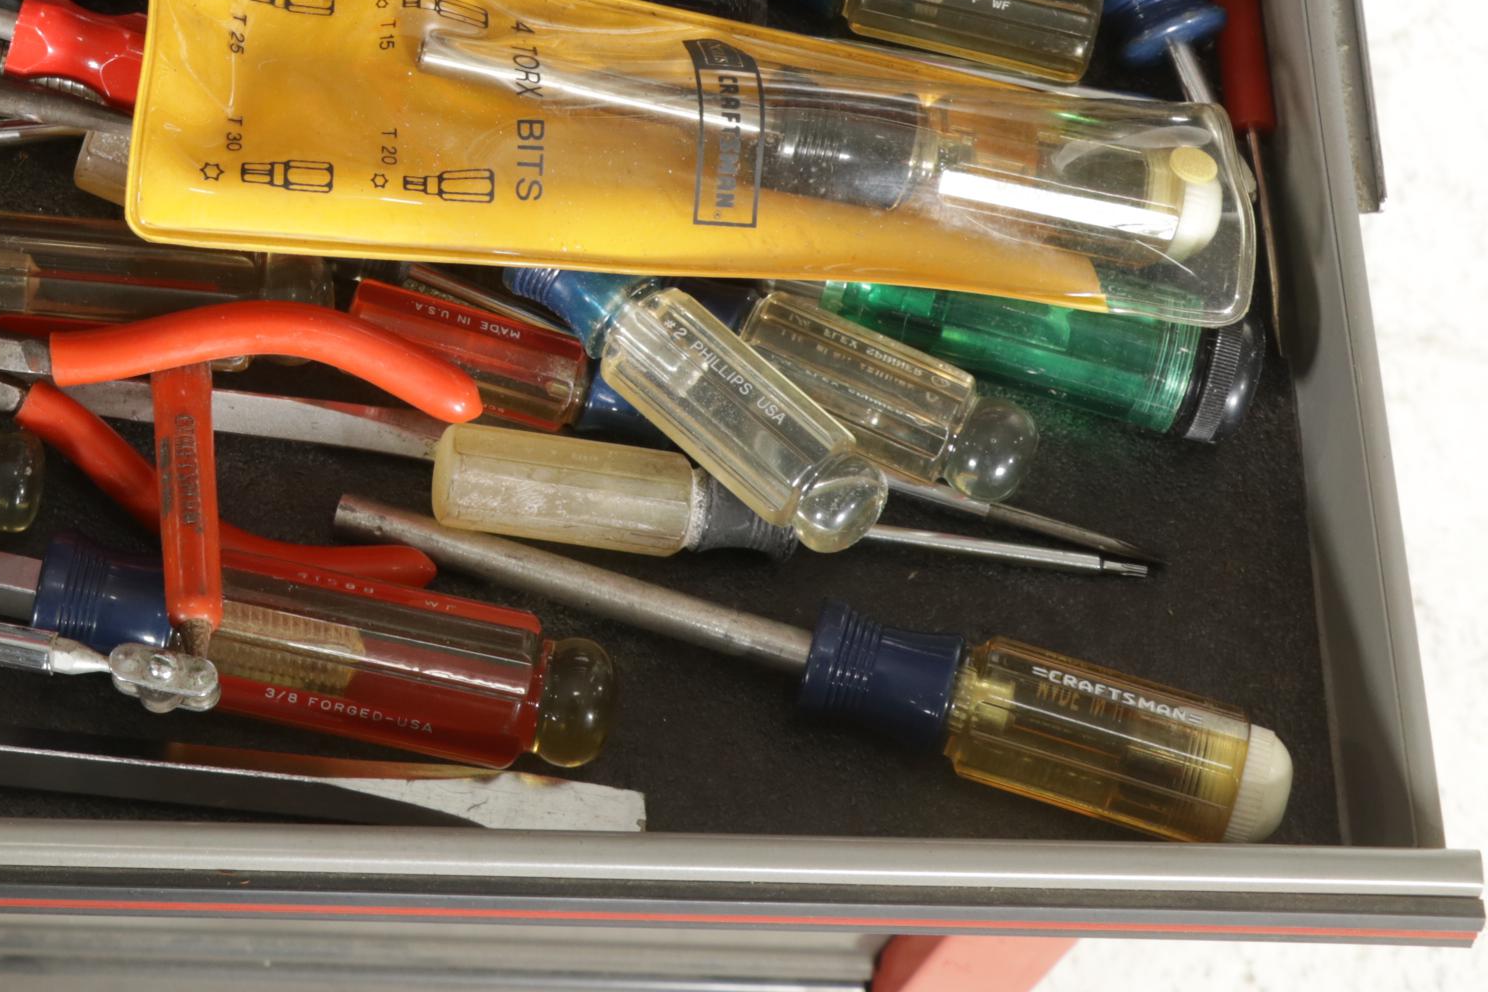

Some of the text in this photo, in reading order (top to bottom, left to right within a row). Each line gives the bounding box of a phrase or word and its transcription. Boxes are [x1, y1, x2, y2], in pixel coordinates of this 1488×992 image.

[228, 14, 248, 55] T 25
[379, 19, 397, 51] T 15
[510, 20, 546, 202] 4 TORX BITS
[225, 115, 243, 153] T 30
[380, 127, 399, 167] T 20
[456, 314, 472, 327] IN
[479, 320, 521, 340] MADE
[689, 340, 754, 396] PHILLIPS
[756, 395, 787, 426] USA
[264, 687, 434, 735] 3/8 FORGED-USA
[1040, 668, 1195, 723] CRAFTSMAN
